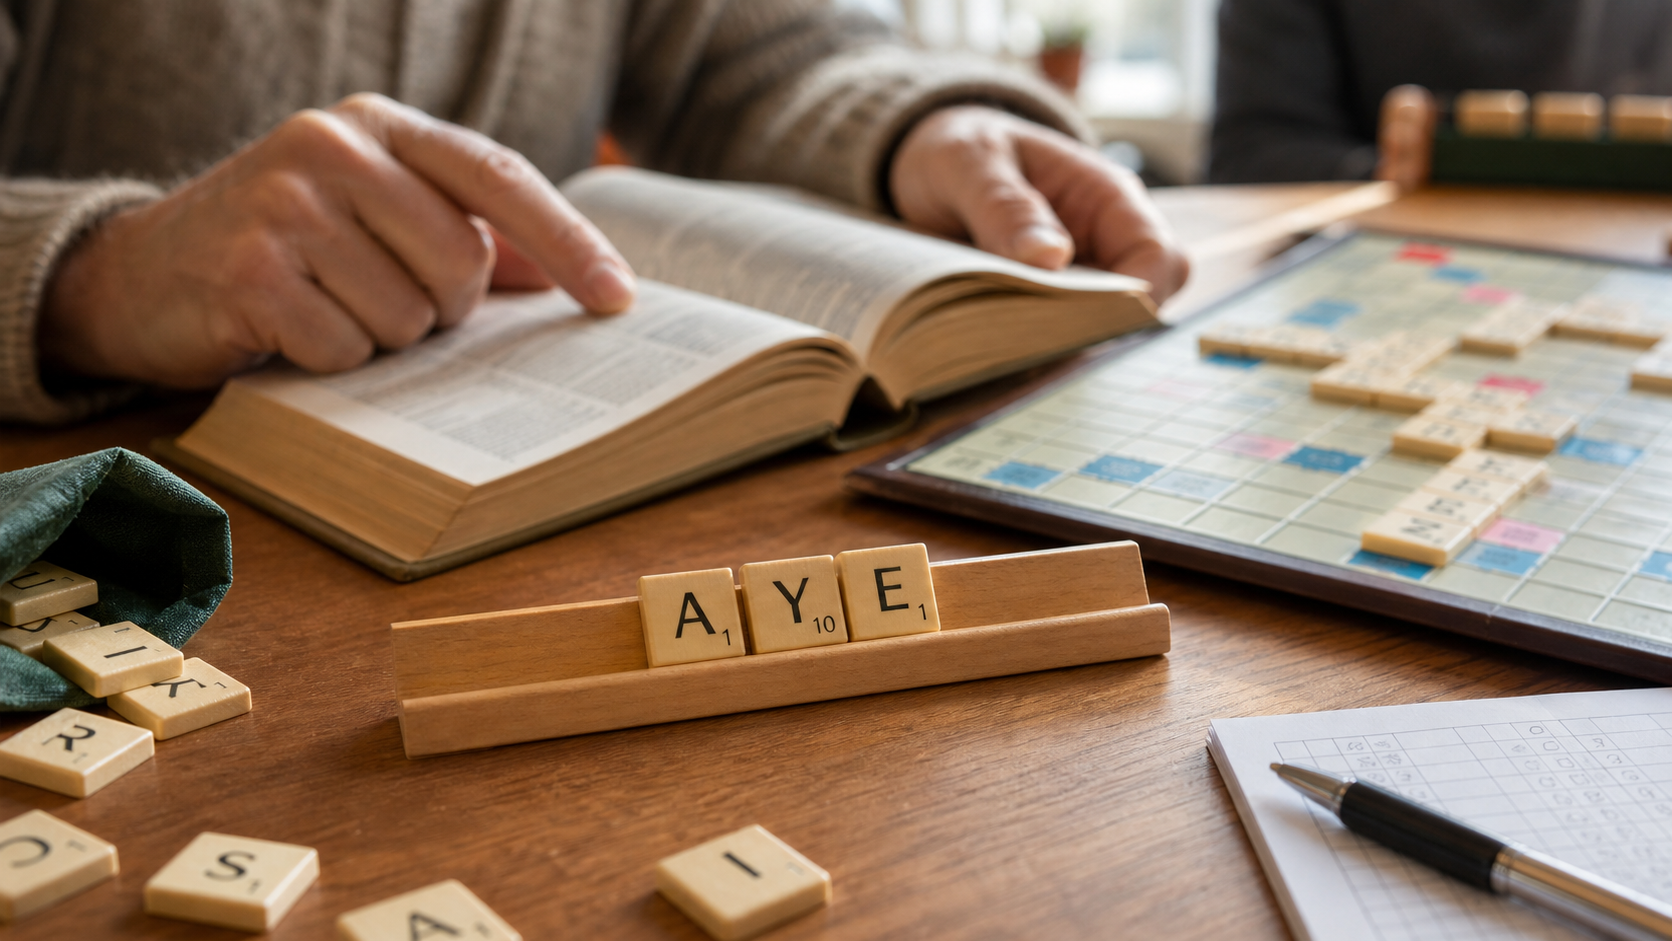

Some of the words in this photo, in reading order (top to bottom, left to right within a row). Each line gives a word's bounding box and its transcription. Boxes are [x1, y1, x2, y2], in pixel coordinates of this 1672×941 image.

[674, 566, 910, 639] AYE
[722, 628, 731, 646] 1
[812, 615, 836, 634] 10
[917, 603, 928, 621] 1
[41, 724, 97, 752] R
[203, 850, 256, 882] S
